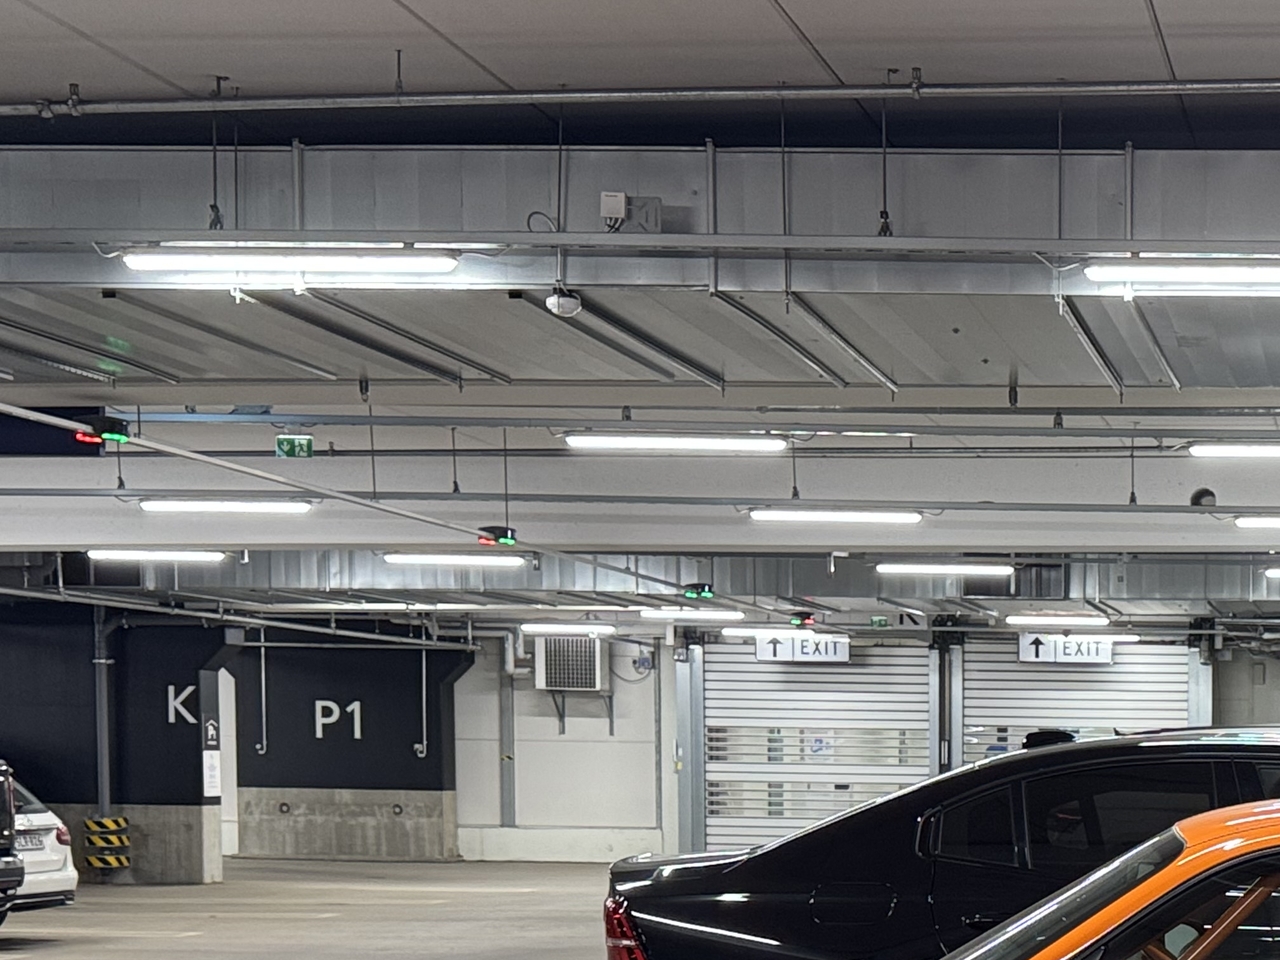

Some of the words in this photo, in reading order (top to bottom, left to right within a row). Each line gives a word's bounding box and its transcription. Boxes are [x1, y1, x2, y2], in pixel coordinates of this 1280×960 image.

[801, 639, 840, 656] EXIT
[1063, 641, 1102, 656] EXIT
[167, 685, 199, 724] K
[315, 700, 362, 740] P1
